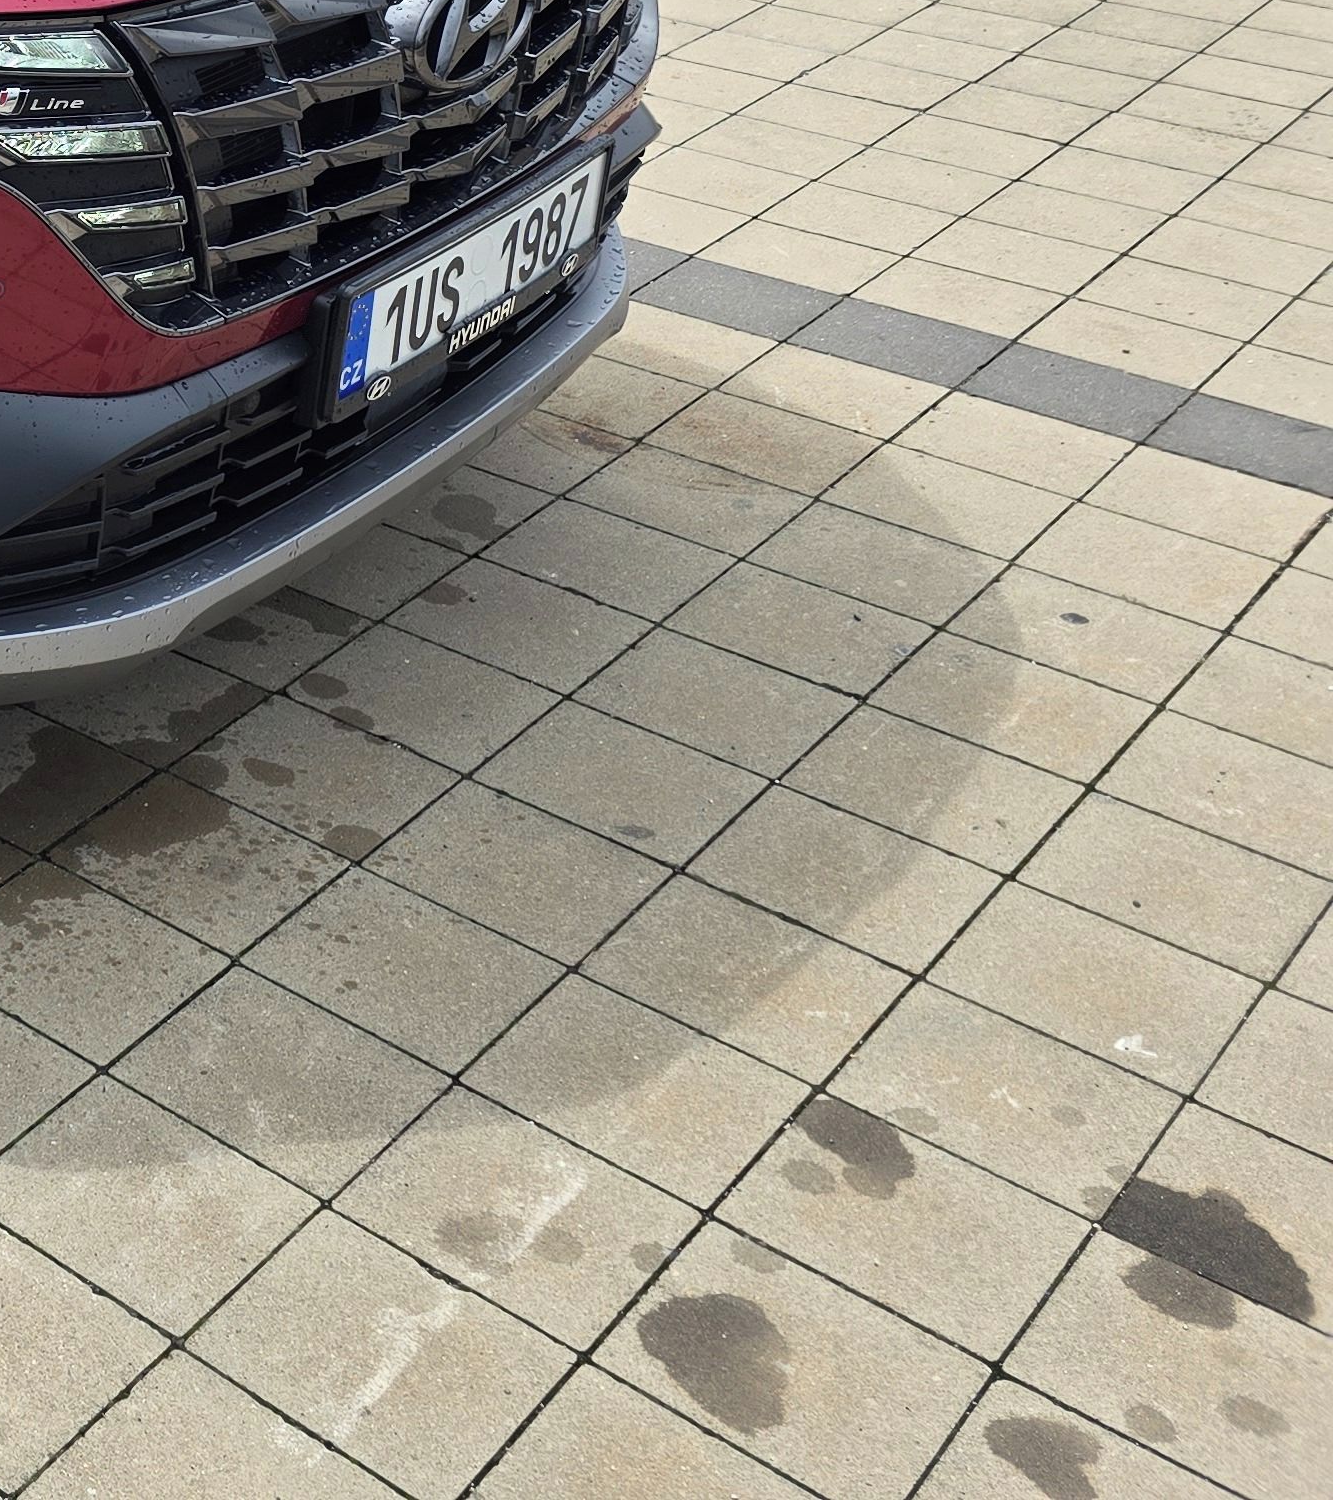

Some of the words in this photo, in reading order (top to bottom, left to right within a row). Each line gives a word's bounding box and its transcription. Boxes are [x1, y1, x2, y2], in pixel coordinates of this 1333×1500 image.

[30, 98, 85, 111] Line
[385, 255, 465, 366] 1US
[500, 173, 590, 295] 1987
[448, 296, 517, 355] HYUNDAI
[339, 359, 365, 391] CZ
